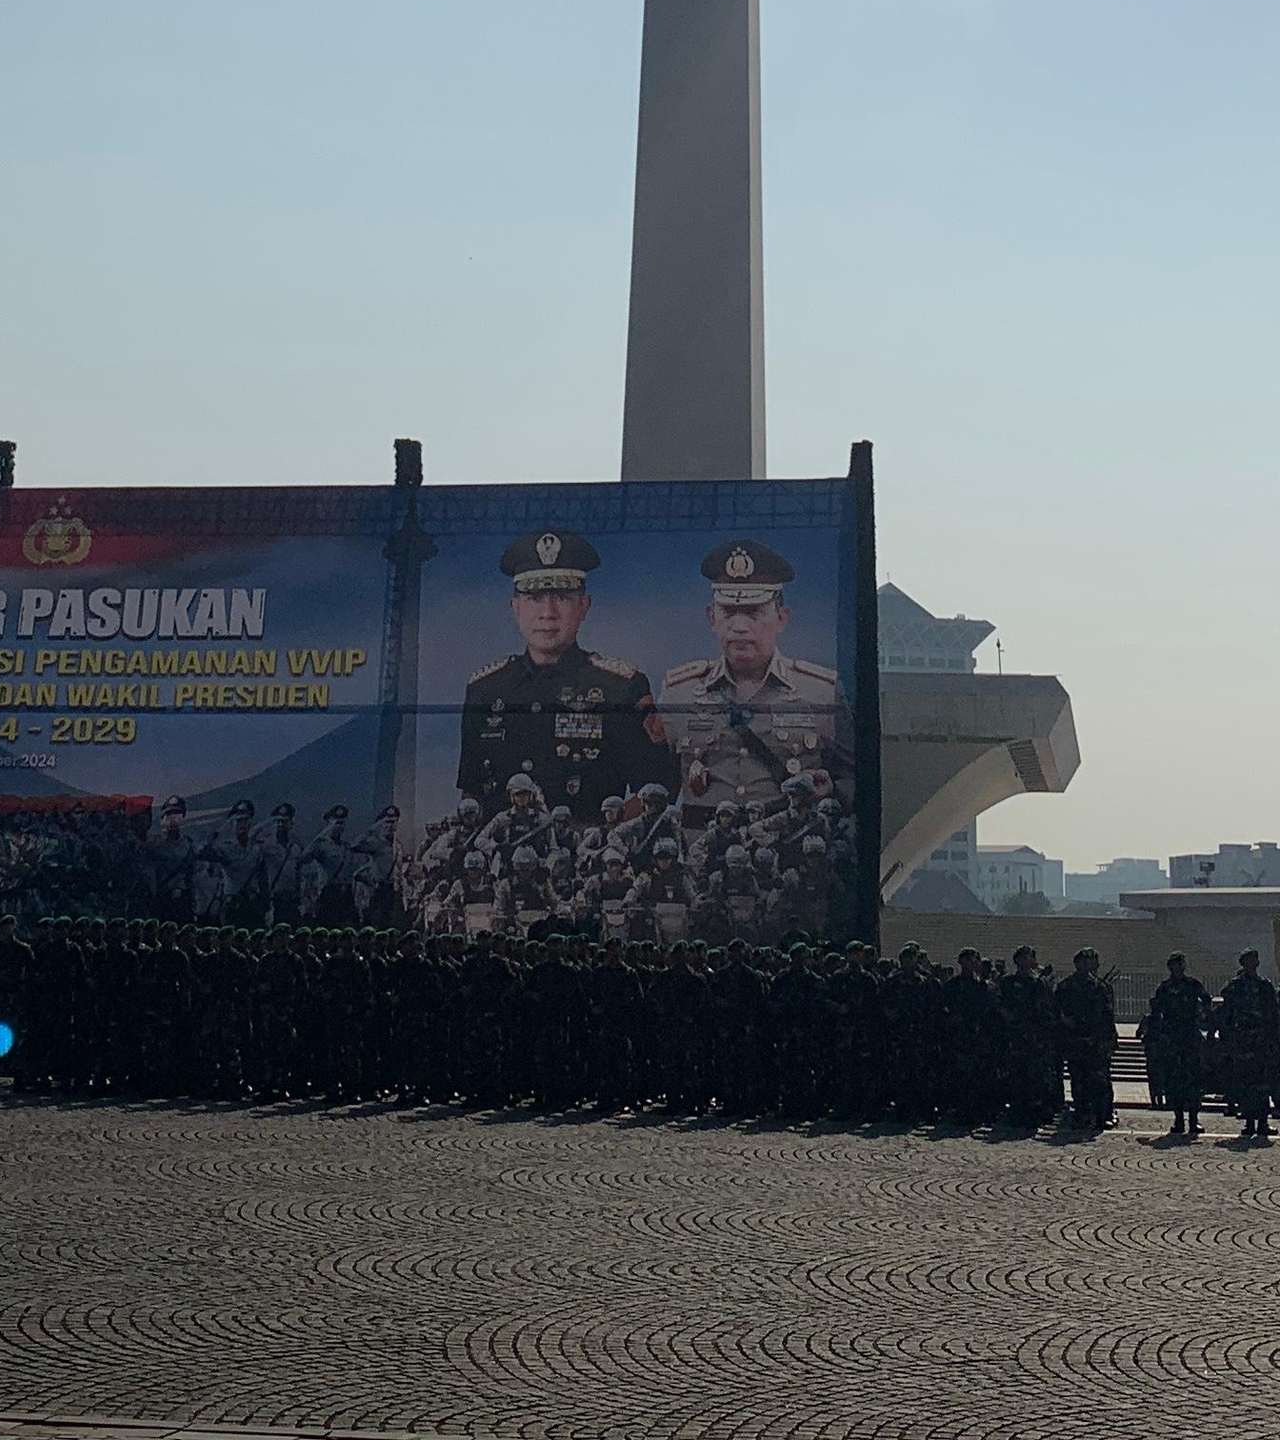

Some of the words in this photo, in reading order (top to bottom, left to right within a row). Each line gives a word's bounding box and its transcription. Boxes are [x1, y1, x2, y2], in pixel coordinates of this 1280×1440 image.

[17, 588, 268, 641] PASUKAN
[34, 648, 280, 677] PENGAMANAN
[288, 647, 367, 677] VVIP
[66, 683, 166, 710] WAKIL
[174, 683, 330, 710] PRESIDEN
[50, 717, 138, 745] 2029
[20, 753, 57, 768] 2024
